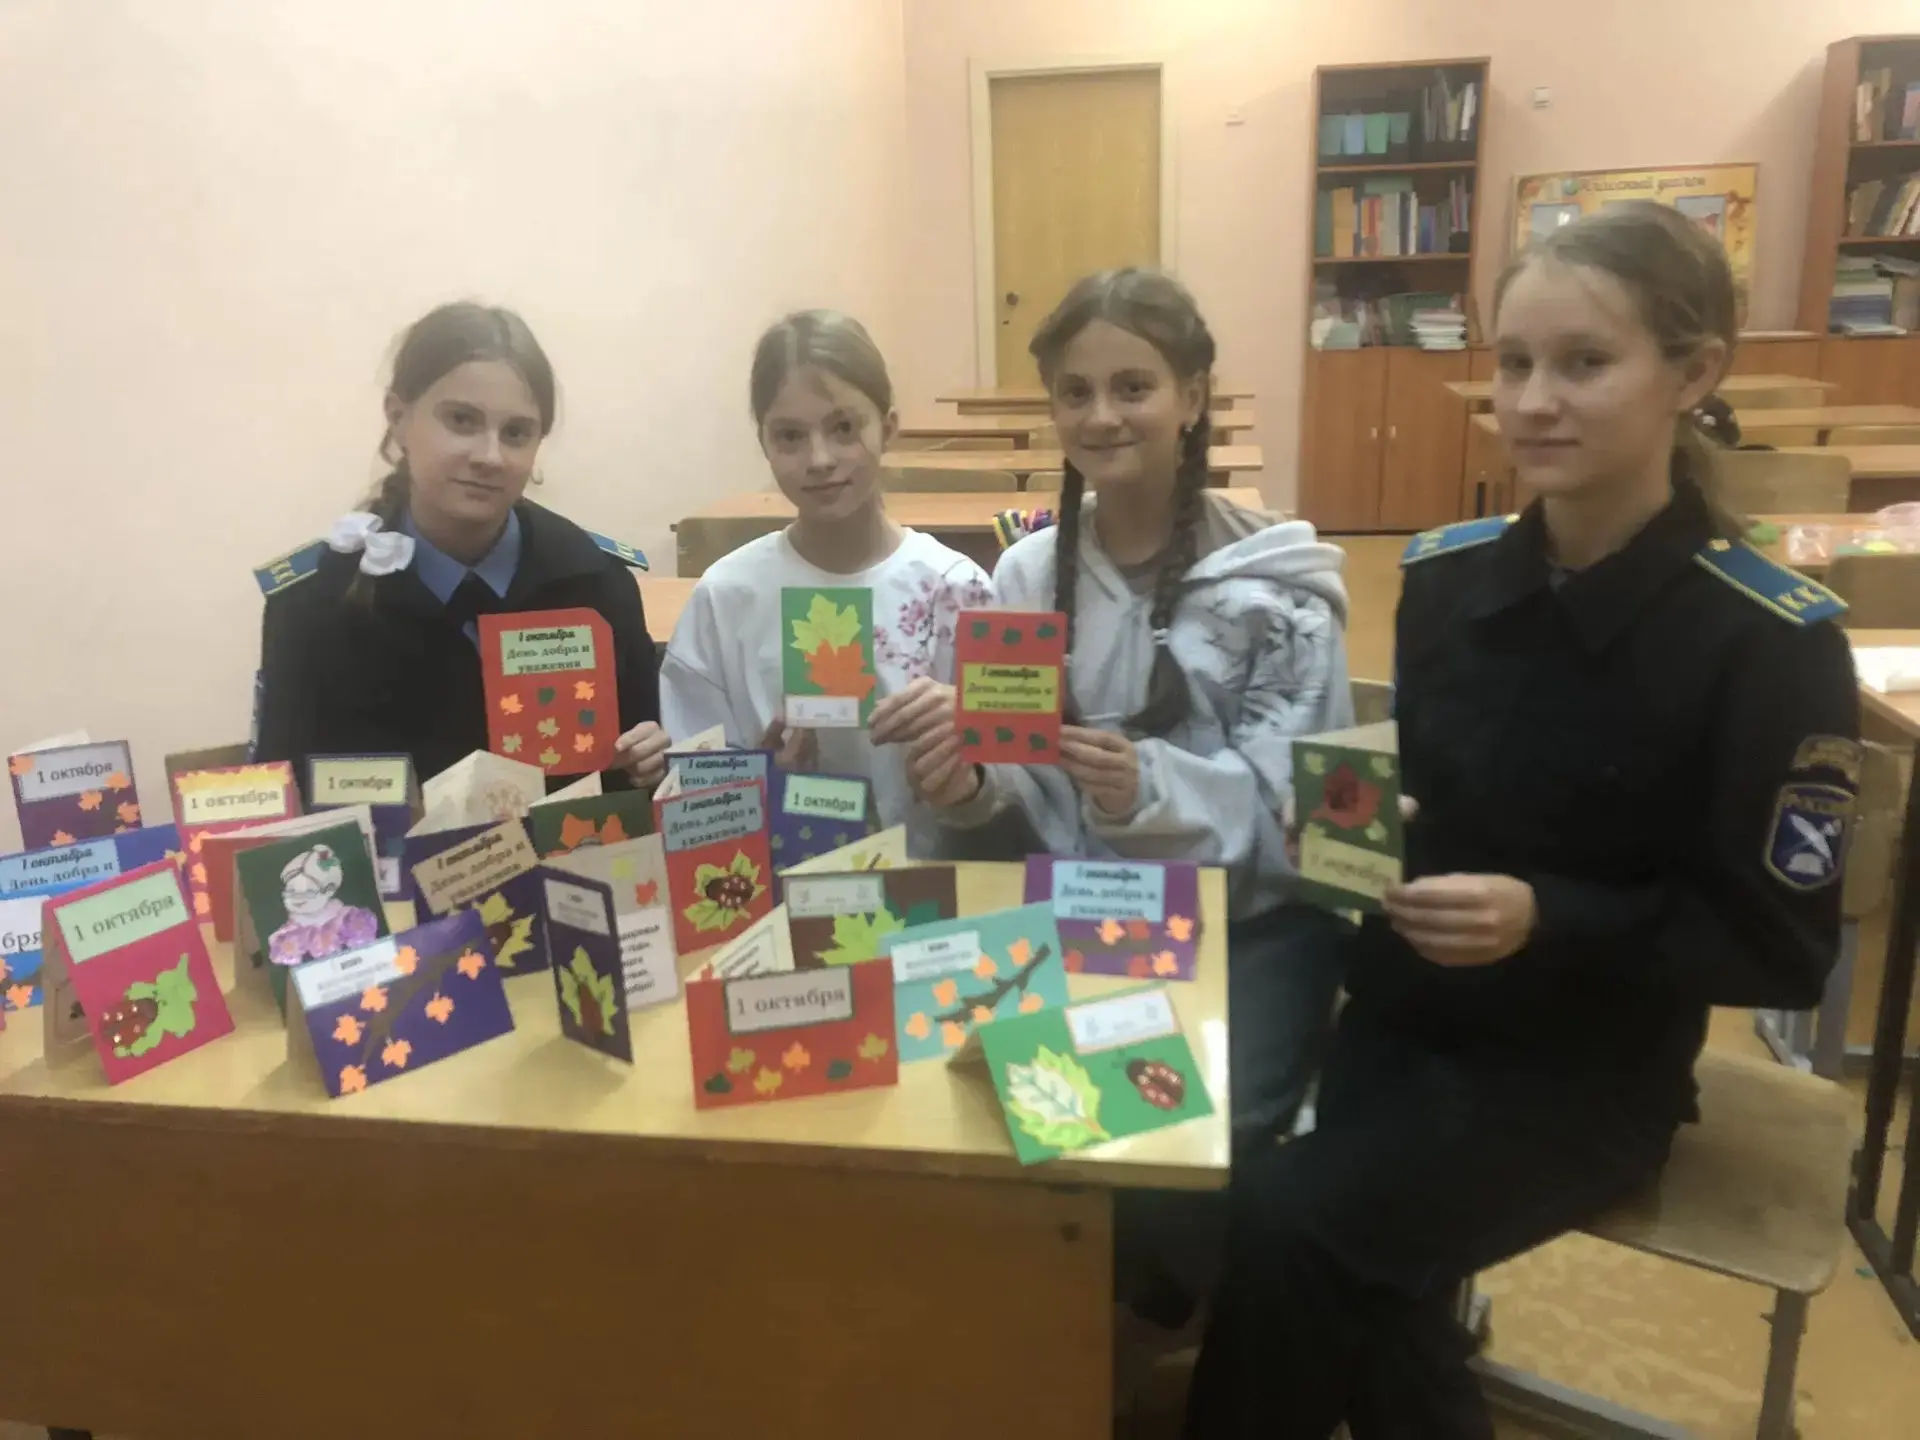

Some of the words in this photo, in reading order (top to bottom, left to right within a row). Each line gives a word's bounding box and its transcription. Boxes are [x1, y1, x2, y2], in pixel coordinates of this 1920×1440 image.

[526, 629, 576, 642] октября
[507, 649, 539, 660] День
[542, 644, 579, 656] добра
[582, 644, 590, 653] и
[37, 770, 46, 784] 1
[50, 762, 113, 783] октября
[695, 757, 748, 771] октября
[328, 776, 335, 790] 1
[339, 775, 393, 791] октября
[191, 797, 198, 810] 1
[205, 789, 279, 809] октября
[689, 792, 742, 811] октября
[794, 792, 800, 806] 1
[803, 796, 856, 813] октября
[669, 821, 704, 835] День
[706, 808, 746, 824] добра
[748, 806, 758, 817] и
[31, 847, 94, 869] октября
[9, 878, 48, 892] День
[54, 865, 99, 882] добра
[104, 861, 113, 872] и
[74, 924, 84, 942] 1
[92, 894, 175, 935] октября
[737, 997, 745, 1016] 1
[755, 988, 846, 1013] октября
